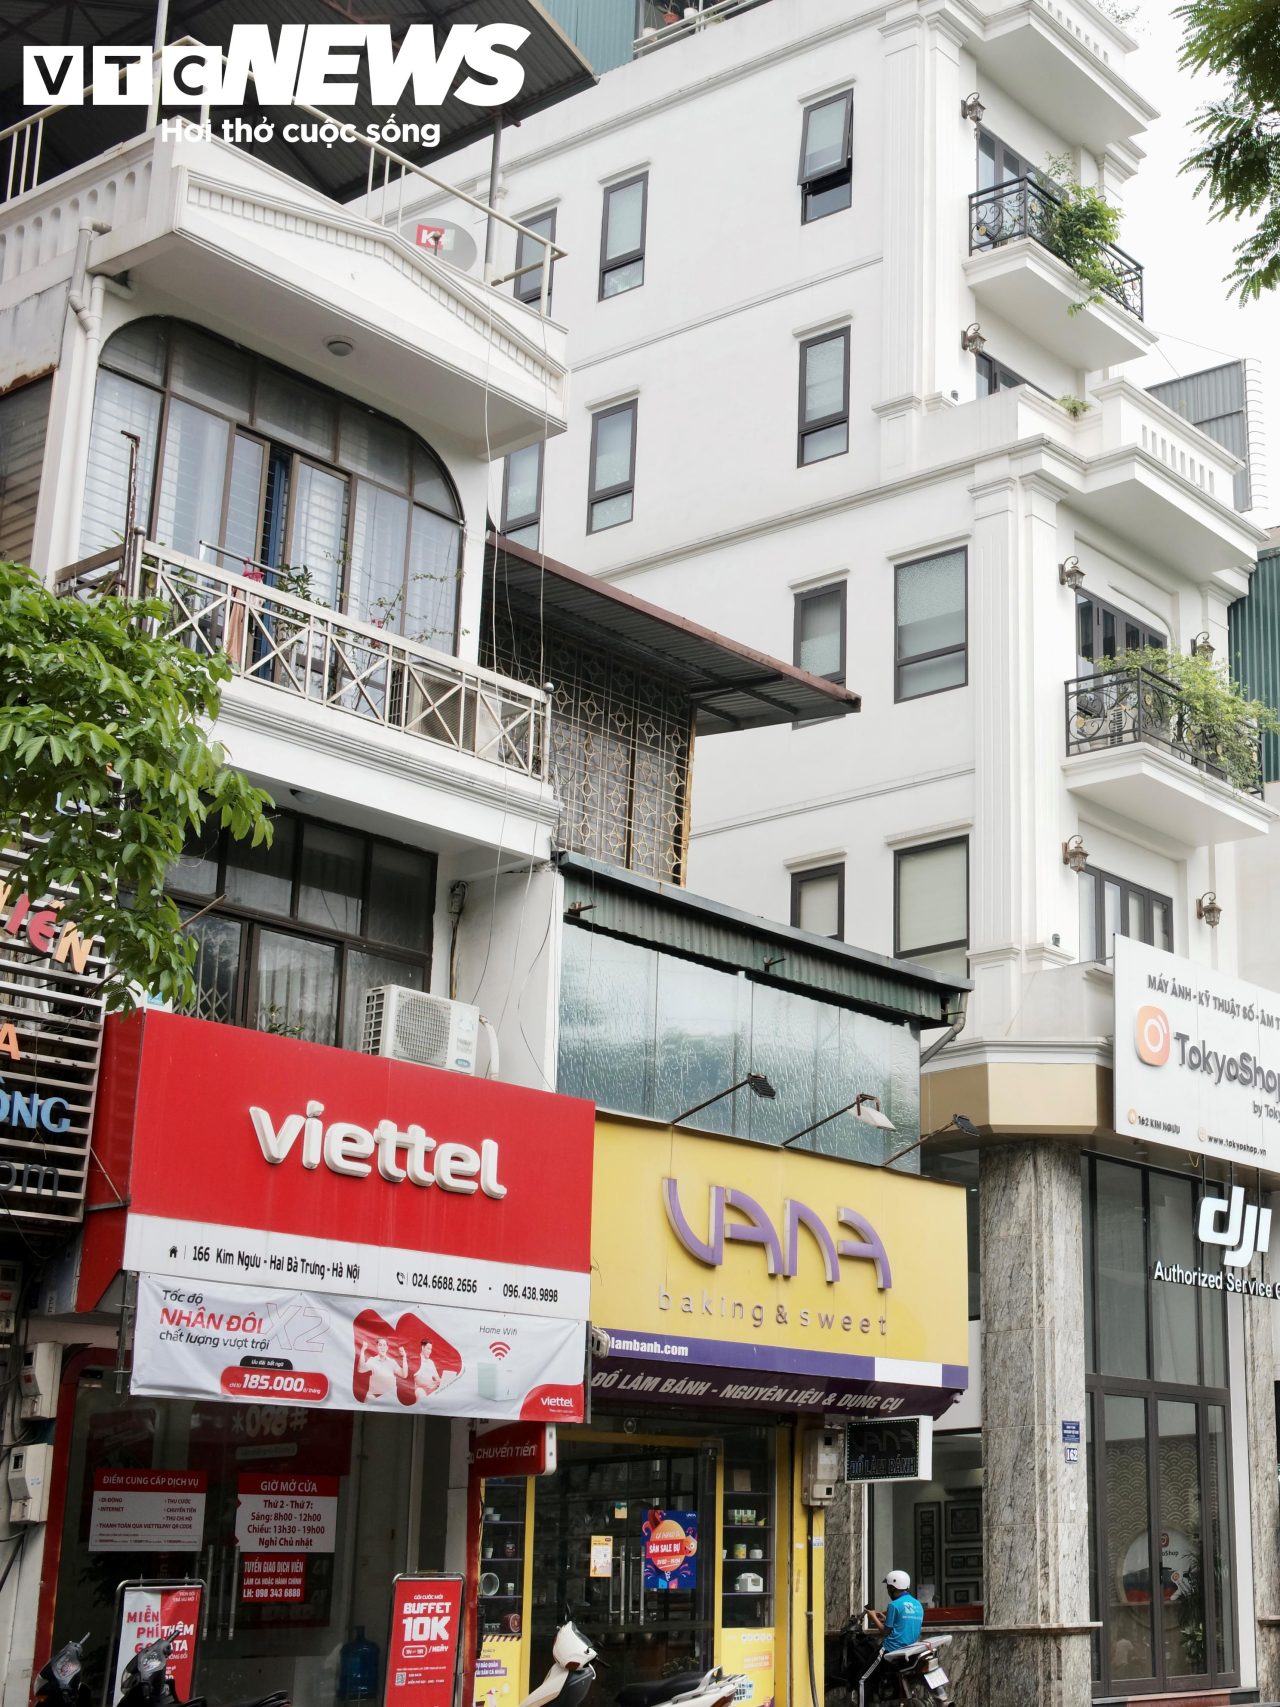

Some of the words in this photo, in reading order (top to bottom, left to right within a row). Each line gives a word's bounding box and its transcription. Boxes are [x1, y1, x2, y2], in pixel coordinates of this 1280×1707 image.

[1148, 973, 1168, 993] MÁY
[1171, 978, 1192, 1001] ẢNH
[1199, 990, 1210, 1006] KỸ
[1213, 997, 1240, 1021] THUẬT
[1243, 1003, 1255, 1021] SỐ
[1260, 1009, 1274, 1028] ÂM
[1253, 1101, 1262, 1116] by
[249, 1100, 510, 1200] viettel
[1208, 1134, 1266, 1156] www.tokyoshop.vn
[193, 1246, 210, 1261] 166
[216, 1248, 234, 1265] Kim
[238, 1251, 261, 1271] Ngưu
[270, 1255, 284, 1271] Hai
[287, 1256, 298, 1272] Bà
[301, 1259, 325, 1280] Trưng
[332, 1262, 343, 1277] Hà
[347, 1264, 360, 1283] Nội
[1154, 1260, 1223, 1289] Authorized
[1227, 1273, 1273, 1298] Service
[163, 1289, 185, 1303] Tốc
[187, 1293, 203, 1306] độ
[503, 1284, 558, 1302] 096.438.9898
[658, 1285, 763, 1327] baking
[775, 1304, 788, 1325] &
[800, 1308, 887, 1336] sweet
[160, 1307, 224, 1331] NHÂN
[226, 1312, 263, 1334] ĐÔI
[266, 1303, 330, 1352] X2
[160, 1328, 183, 1342] chất
[186, 1333, 219, 1348] lượng
[223, 1337, 248, 1350] vượt
[251, 1338, 270, 1351] trội
[480, 1326, 500, 1335] Home
[502, 1327, 517, 1336] Wifi
[243, 1374, 304, 1392] 185.000
[618, 1372, 657, 1391] LÀM
[659, 1374, 710, 1396] BÁNH
[719, 1381, 786, 1402] NGUYÊN
[788, 1385, 824, 1407] LIỆU
[822, 1392, 833, 1406] &
[836, 1392, 879, 1411] DỤNG
[879, 1396, 904, 1414] CỤ
[541, 1397, 573, 1408] viettel
[103, 1474, 123, 1484] ĐIỂM
[125, 1477, 149, 1485] CUNG
[150, 1476, 166, 1485] CẤP
[168, 1478, 187, 1487] DỊCH
[188, 1479, 199, 1488] VỤ
[260, 1480, 279, 1491] GIỜ
[280, 1480, 297, 1492] MỞ
[298, 1481, 317, 1493] CỬA
[263, 1499, 279, 1509] Thứ
[279, 1501, 284, 1509] 2
[290, 1500, 305, 1509] Thứ
[306, 1501, 313, 1510] 7:
[251, 1512, 272, 1524] Sáng:
[274, 1513, 292, 1521] 8h00
[299, 1513, 321, 1522] 12h00
[247, 1524, 272, 1534] Chiều:
[273, 1525, 296, 1534] 13h30
[302, 1526, 325, 1534] 19h00
[258, 1536, 278, 1548] Nghỉ
[279, 1537, 294, 1546] Chủ
[295, 1538, 313, 1549] nhật
[660, 1544, 672, 1552] SALE
[244, 1557, 262, 1573] TUYỂN
[263, 1562, 276, 1573] GIAO
[277, 1562, 290, 1575] DỊCH
[243, 1589, 254, 1598] LH:
[255, 1589, 269, 1598] 098
[270, 1589, 282, 1597] 343
[284, 1588, 301, 1597] 6888
[403, 1602, 451, 1614] BUFFET
[402, 1616, 451, 1641] 10K
